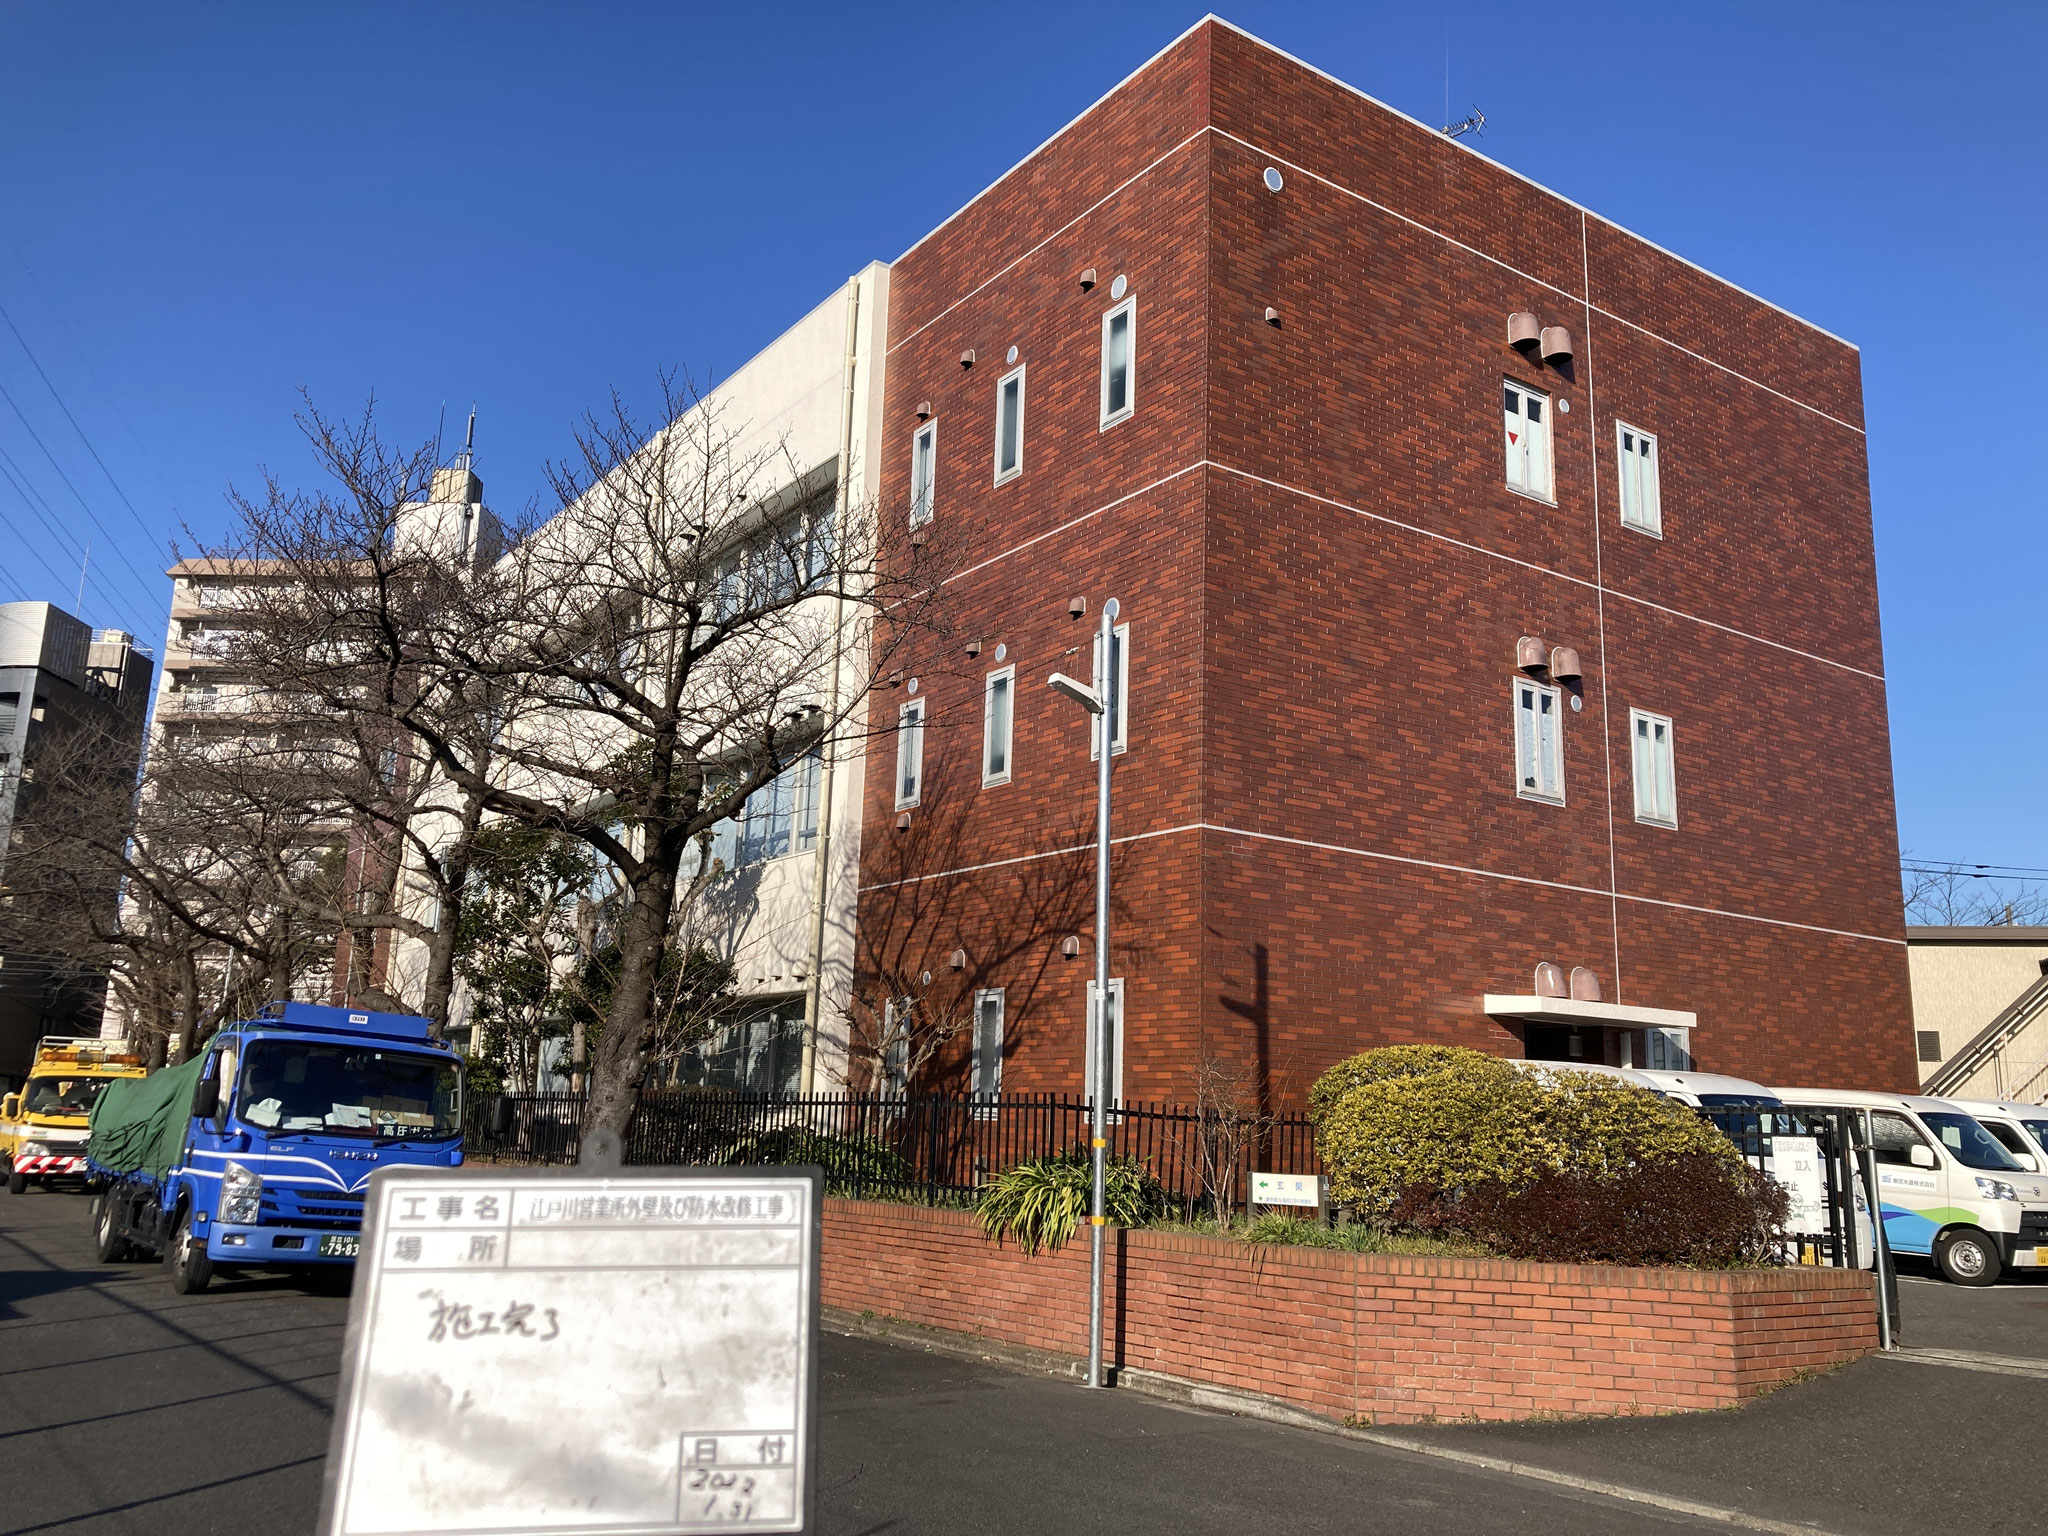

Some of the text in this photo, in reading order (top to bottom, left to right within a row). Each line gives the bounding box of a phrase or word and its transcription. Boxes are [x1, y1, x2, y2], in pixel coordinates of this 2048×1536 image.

[400, 1195, 500, 1221] 工事名
[327, 1242, 360, 1256] 79-83
